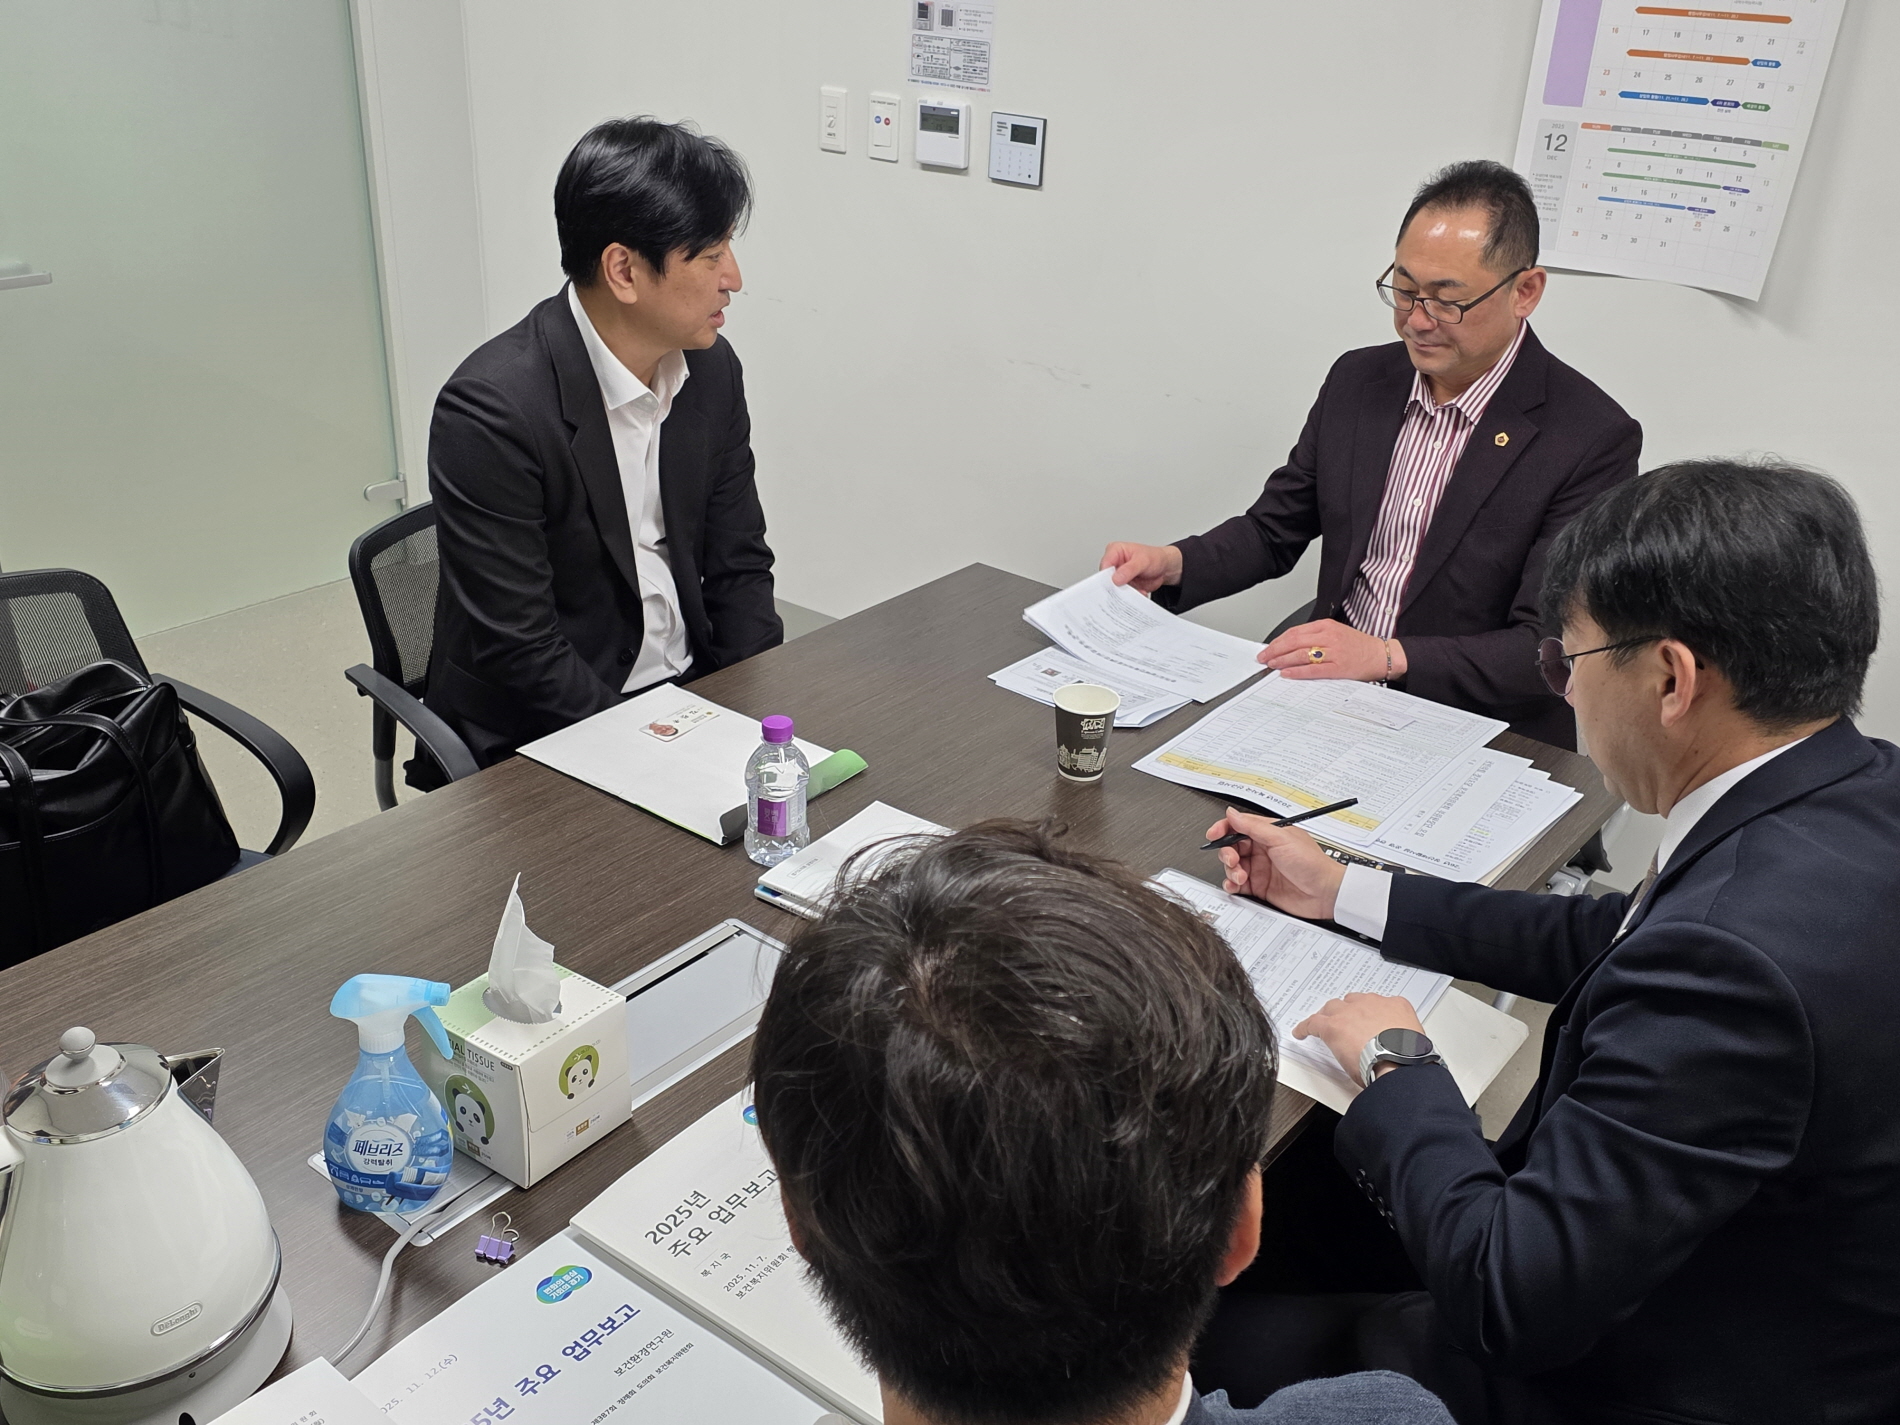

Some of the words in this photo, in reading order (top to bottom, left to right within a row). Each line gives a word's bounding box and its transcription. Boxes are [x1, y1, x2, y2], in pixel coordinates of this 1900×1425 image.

[1673, 31, 1681, 39] 18
[1705, 33, 1713, 41] 19
[1736, 35, 1744, 43] 20
[1767, 38, 1775, 46] 21
[1695, 76, 1703, 84] 26
[1599, 89, 1607, 97] 30
[1544, 133, 1568, 152] 12
[1729, 200, 1737, 208] 19
[1723, 225, 1730, 233] 26
[449, 1038, 465, 1056] IAL
[467, 1048, 495, 1072] TISSUE
[352, 1139, 404, 1157] 페브리즈
[363, 1158, 393, 1166] 강력탈취
[644, 1189, 712, 1245] 2025년
[667, 1226, 713, 1258] 주요
[708, 1169, 779, 1226] 업무보고
[543, 1278, 565, 1295] 변화의
[562, 1269, 578, 1282] 중심
[723, 1274, 747, 1292] 2025.
[744, 1263, 759, 1273] 11.
[756, 1255, 768, 1263] 7.
[735, 1252, 789, 1300] 보건복지위원회
[549, 1283, 571, 1300] 기회의
[568, 1274, 584, 1286] 경기
[157, 1307, 198, 1332] DeLonghi
[514, 1364, 562, 1397] 주요
[561, 1303, 641, 1362] 업무보고
[613, 1328, 675, 1377] 보건환경연구원
[616, 1389, 637, 1405] 정례회
[636, 1373, 656, 1391] 도의회
[655, 1342, 695, 1375] 보건복지위원회
[406, 1382, 424, 1394] 11.
